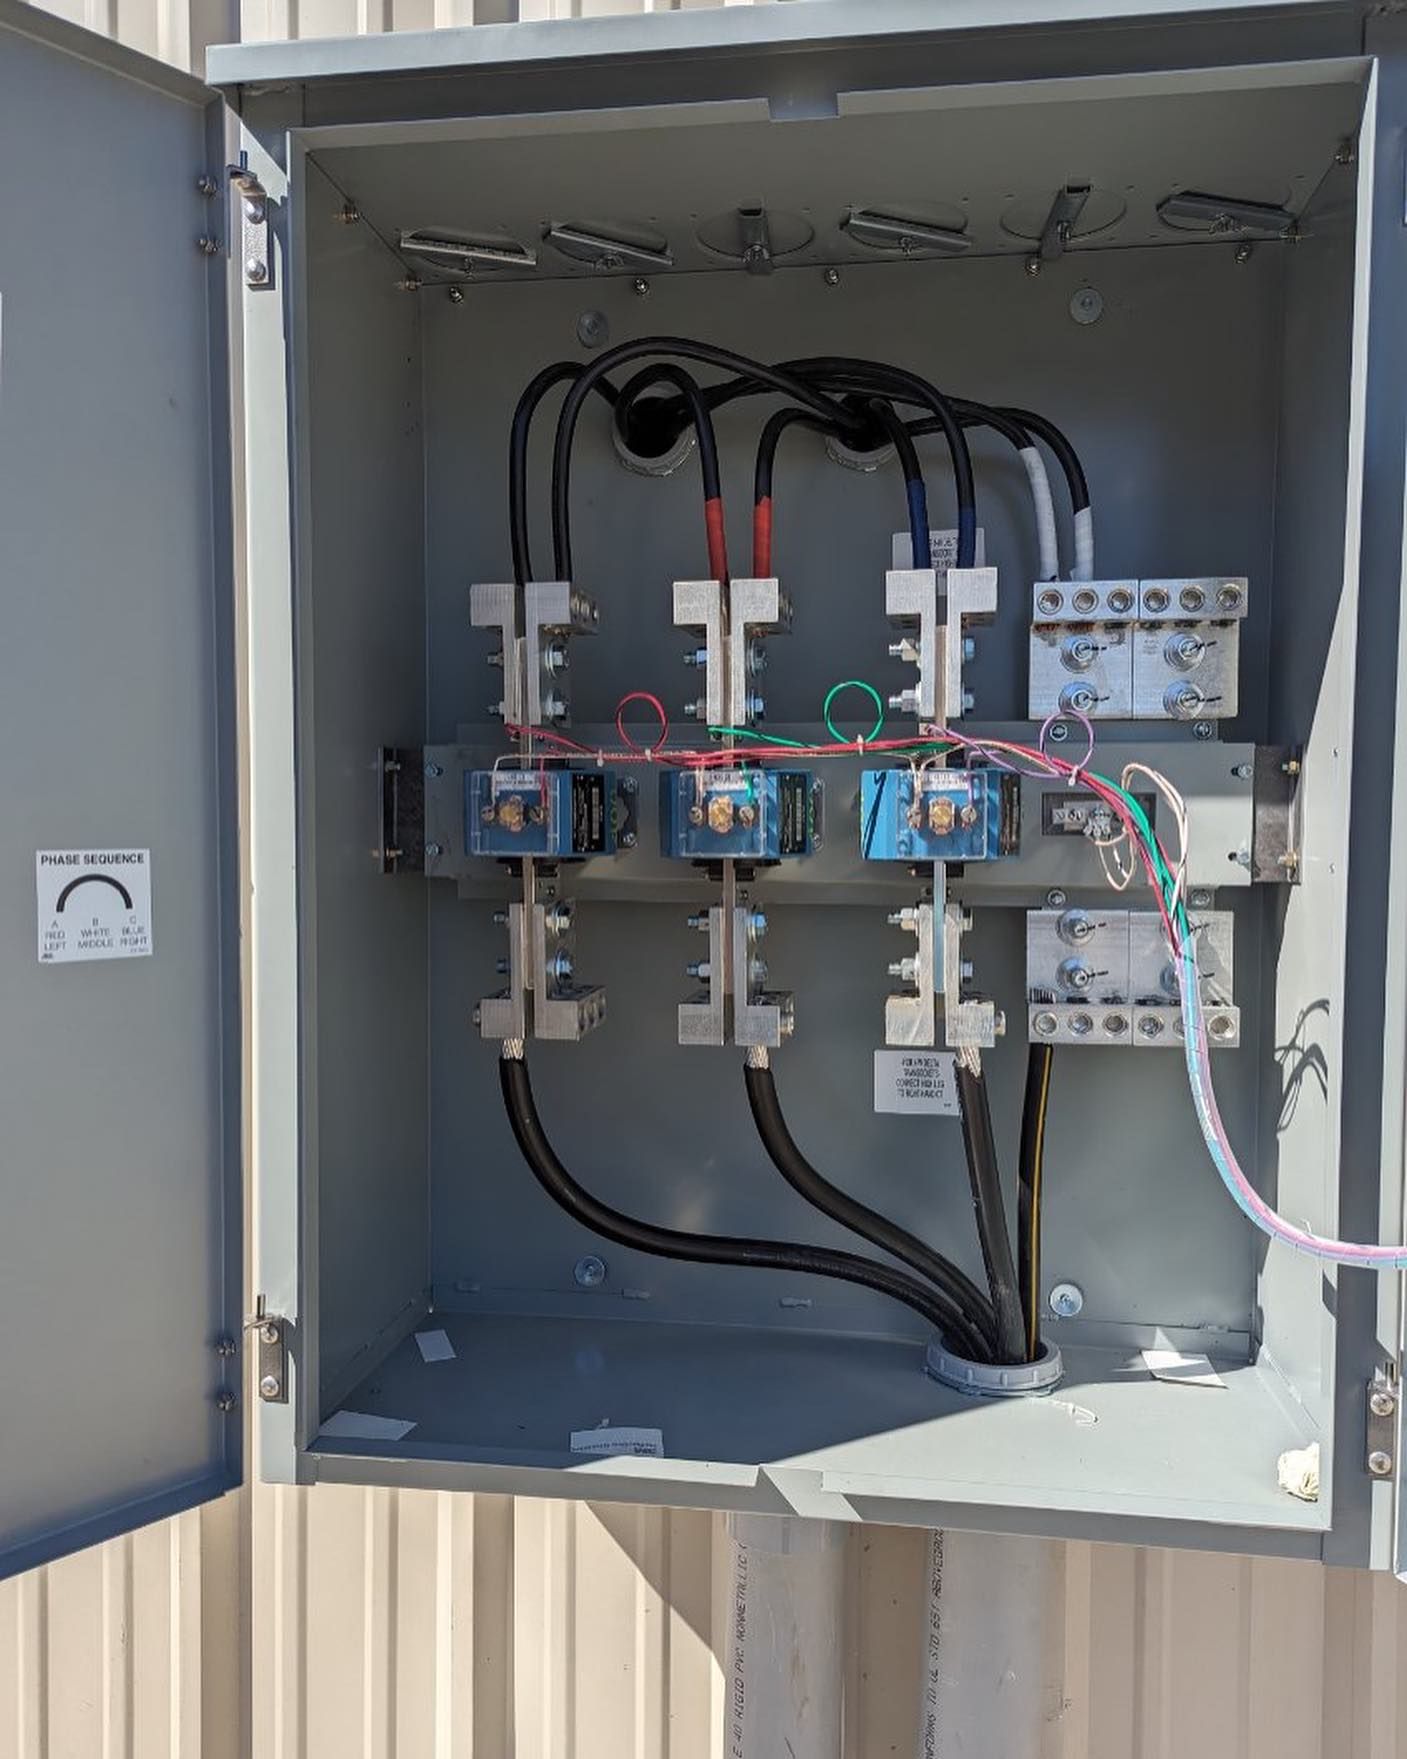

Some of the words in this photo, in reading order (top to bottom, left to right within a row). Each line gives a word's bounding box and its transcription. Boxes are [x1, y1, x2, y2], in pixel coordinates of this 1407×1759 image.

[41, 854, 80, 866] PHASE
[83, 853, 145, 865] SEQUENCE
[51, 920, 59, 929] A
[80, 928, 110, 938] WHITE
[44, 942, 66, 951] LEFT
[78, 939, 114, 949] MIDDLE
[735, 1678, 744, 1720] RIGID
